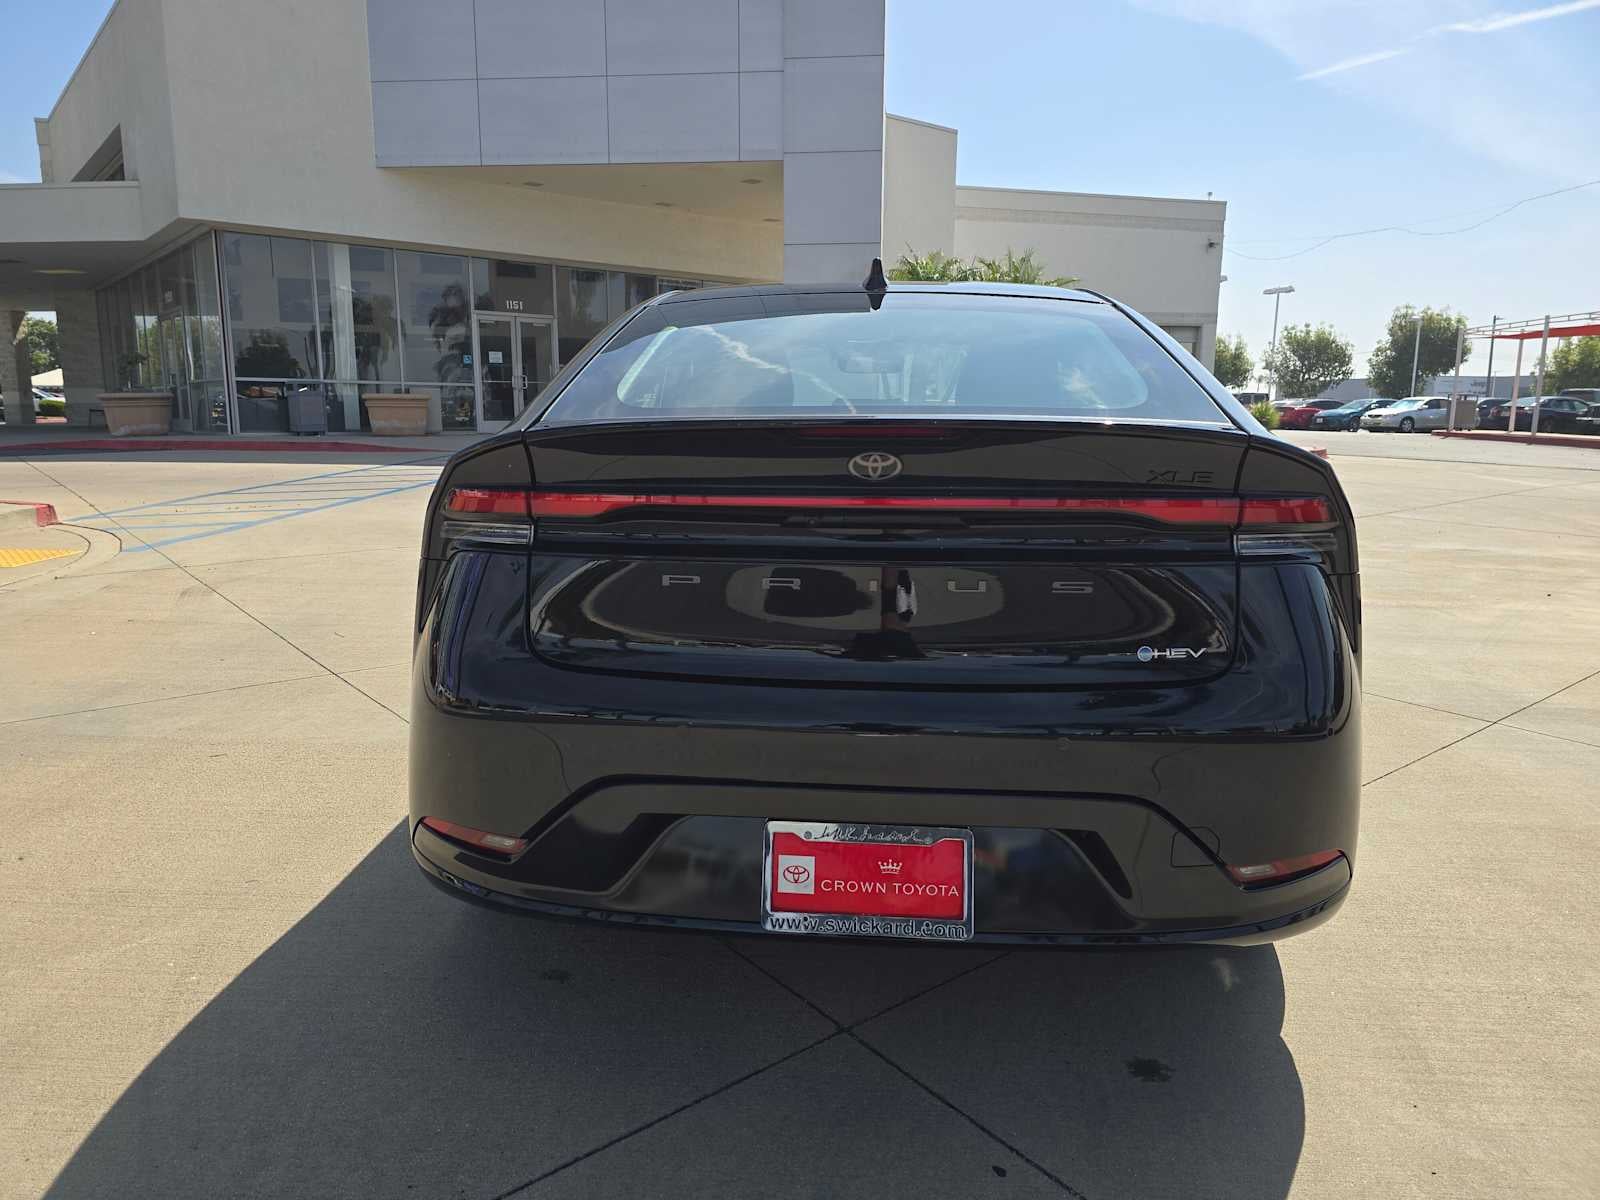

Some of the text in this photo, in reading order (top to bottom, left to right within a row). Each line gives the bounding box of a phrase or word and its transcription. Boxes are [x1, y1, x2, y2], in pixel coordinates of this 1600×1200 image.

[506, 300, 523, 311] 1151
[1146, 470, 1215, 483] XLE
[661, 574, 1095, 593] PRIUS
[820, 879, 960, 897] CROWN TOYOTA
[768, 915, 968, 939] www.swickard.com
